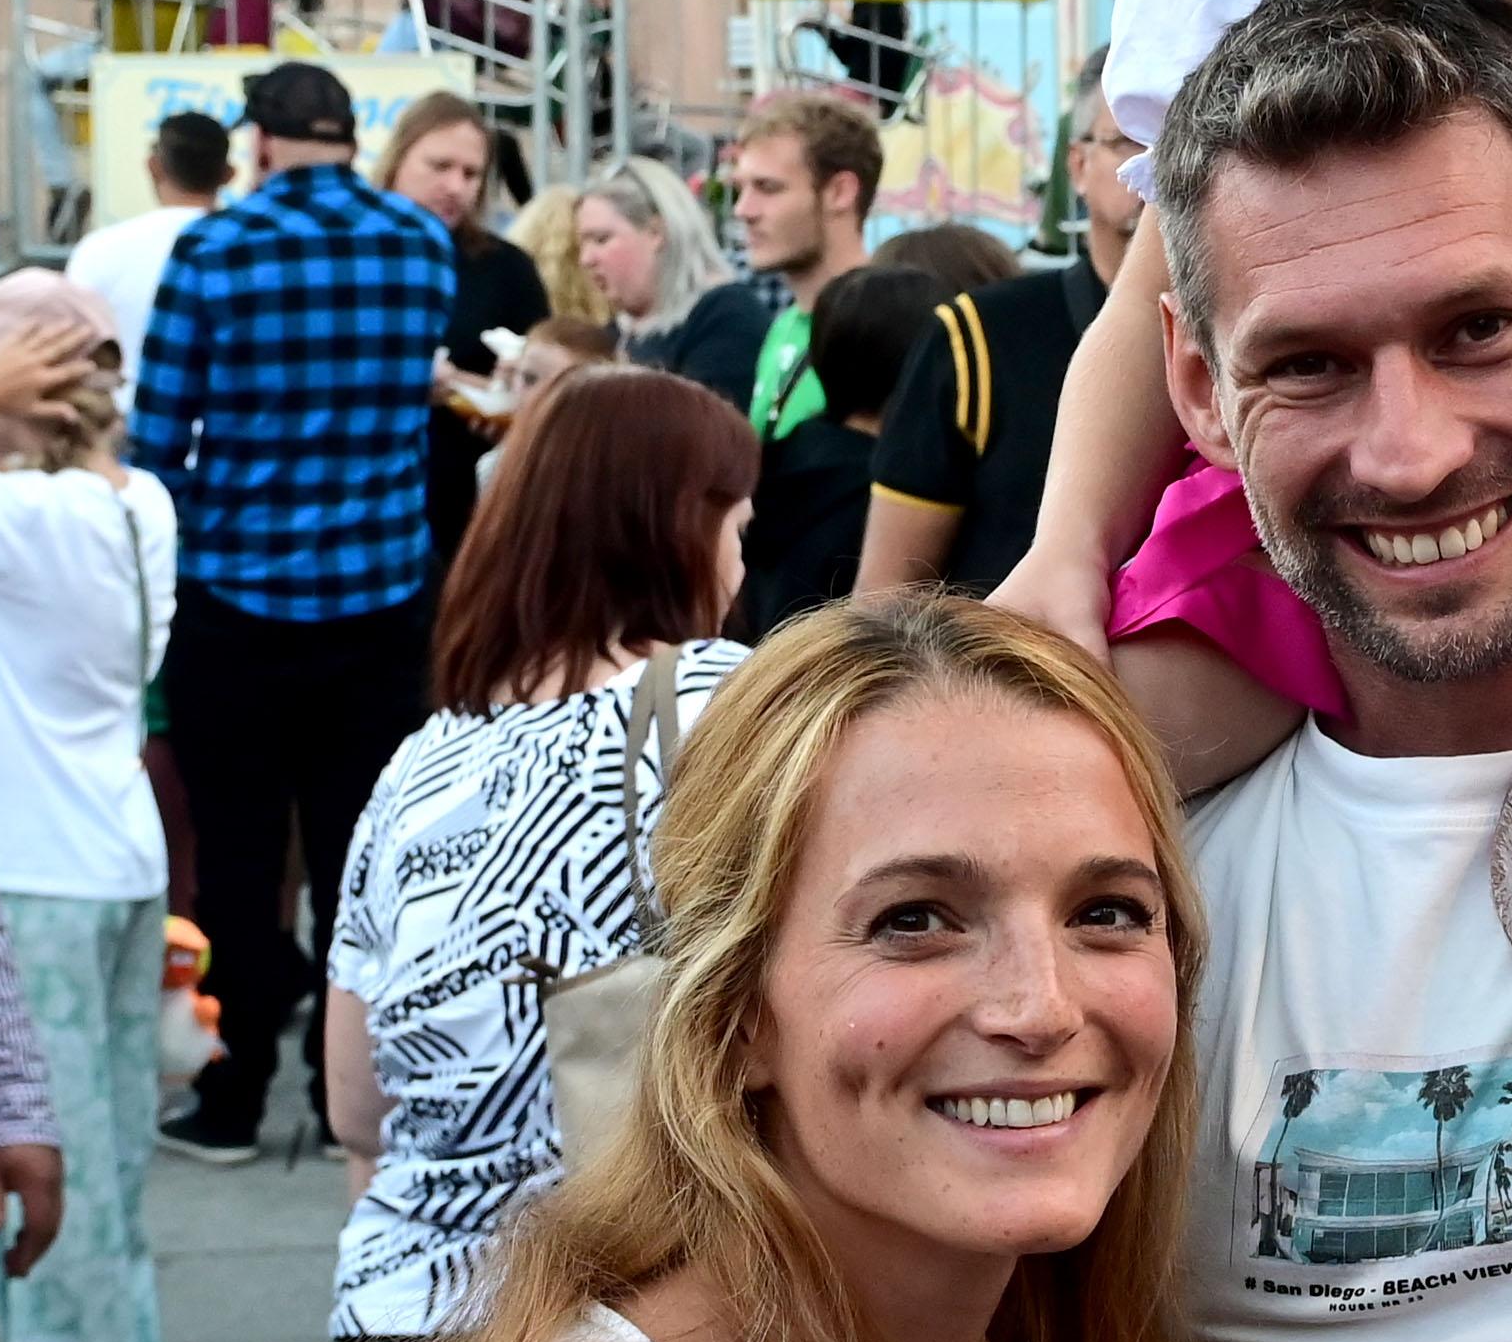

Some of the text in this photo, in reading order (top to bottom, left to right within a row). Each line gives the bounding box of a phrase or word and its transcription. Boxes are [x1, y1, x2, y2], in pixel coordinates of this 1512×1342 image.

[1244, 1276, 1258, 1291] #
[1263, 1279, 1302, 1296] San
[1308, 1283, 1366, 1300] Diego
[1382, 1270, 1458, 1296] BEACH
[1329, 1302, 1375, 1312] HOUSE
